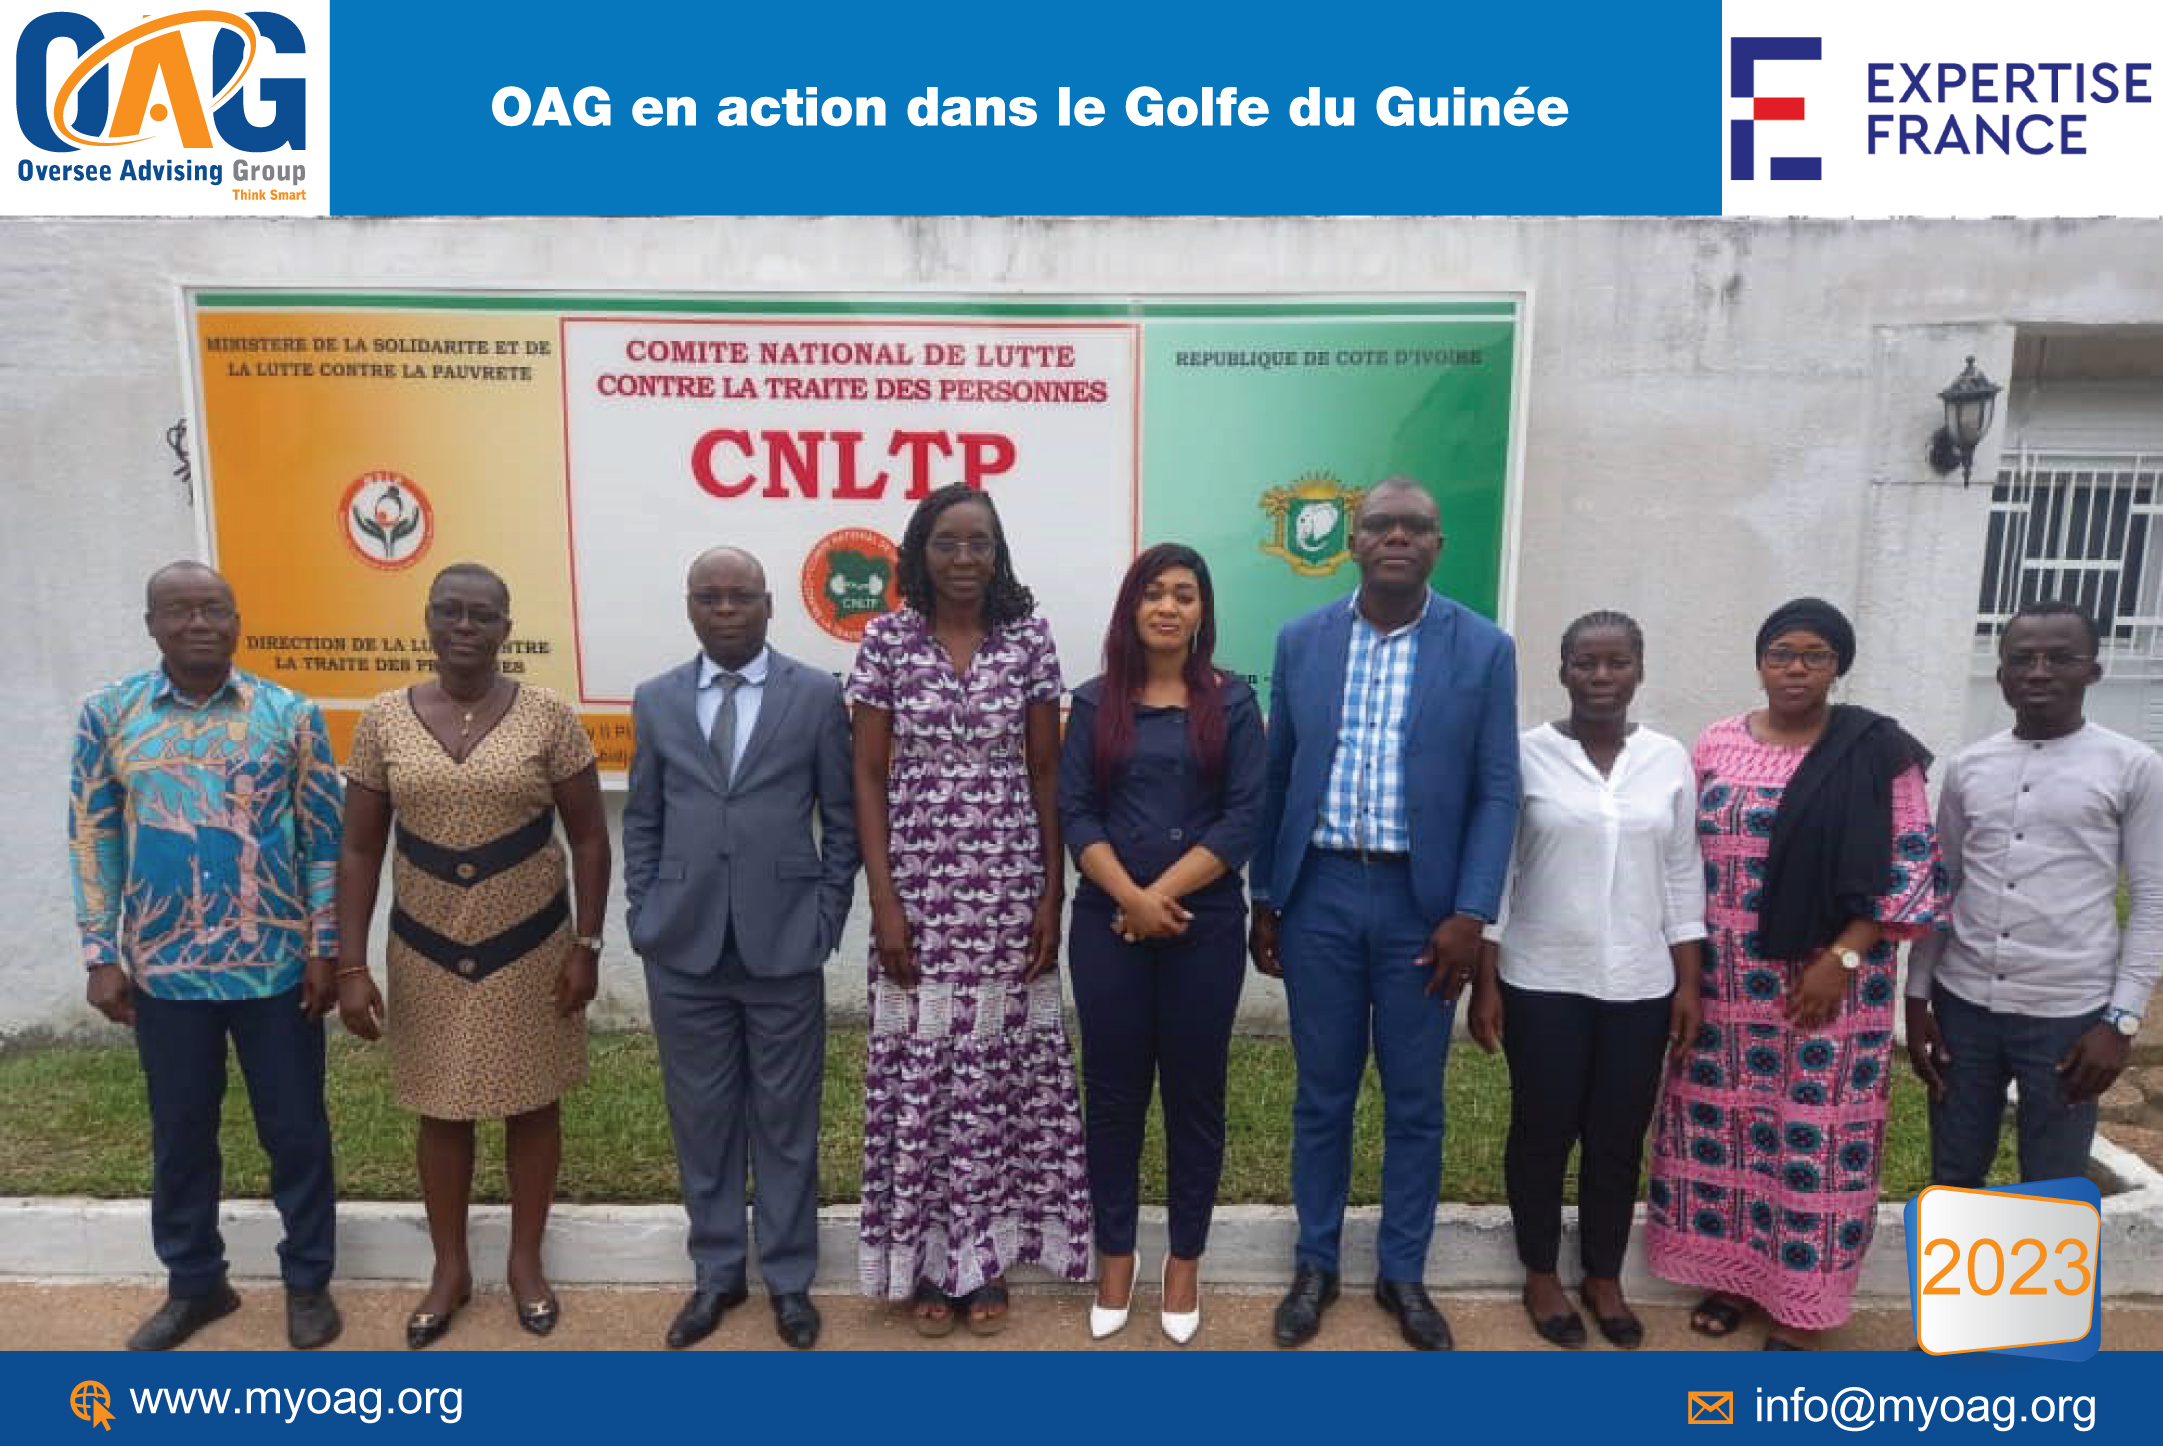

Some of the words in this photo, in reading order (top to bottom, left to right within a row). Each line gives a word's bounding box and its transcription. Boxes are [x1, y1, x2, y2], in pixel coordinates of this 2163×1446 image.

[207, 337, 311, 353] MINISTERE
[313, 338, 340, 353] DE
[344, 338, 368, 353] LA
[374, 338, 488, 355] SOLIDARITE
[495, 340, 519, 355] ET
[526, 341, 552, 355] DE
[625, 340, 747, 364] COMITE
[759, 341, 911, 367] NATIONAL
[923, 344, 964, 367] DE
[979, 345, 1075, 368] LUTTE
[1176, 350, 1298, 370] REPUBLIQUE
[1304, 350, 1329, 366] DE
[1335, 350, 1388, 366] COTE
[1395, 349, 1482, 366] D'IVOIRE
[228, 362, 251, 377] LA
[257, 362, 313, 378] LUTTE
[319, 363, 396, 379] CONTRE
[402, 365, 426, 379] LA
[432, 365, 533, 381] PAUVRETE
[597, 375, 715, 398] CONTRE
[723, 376, 759, 399] LA
[765, 377, 868, 401] TRAITE
[876, 378, 932, 401] DES
[939, 379, 1107, 403] PERSONNES
[691, 428, 1016, 501] CNLTP
[247, 635, 346, 652] DIRECTION
[352, 637, 377, 652] DE
[382, 637, 404, 653] LA
[501, 639, 551, 655] NTRE
[275, 655, 298, 671] LA
[303, 656, 370, 672] TRAITE
[375, 657, 411, 673] DES
